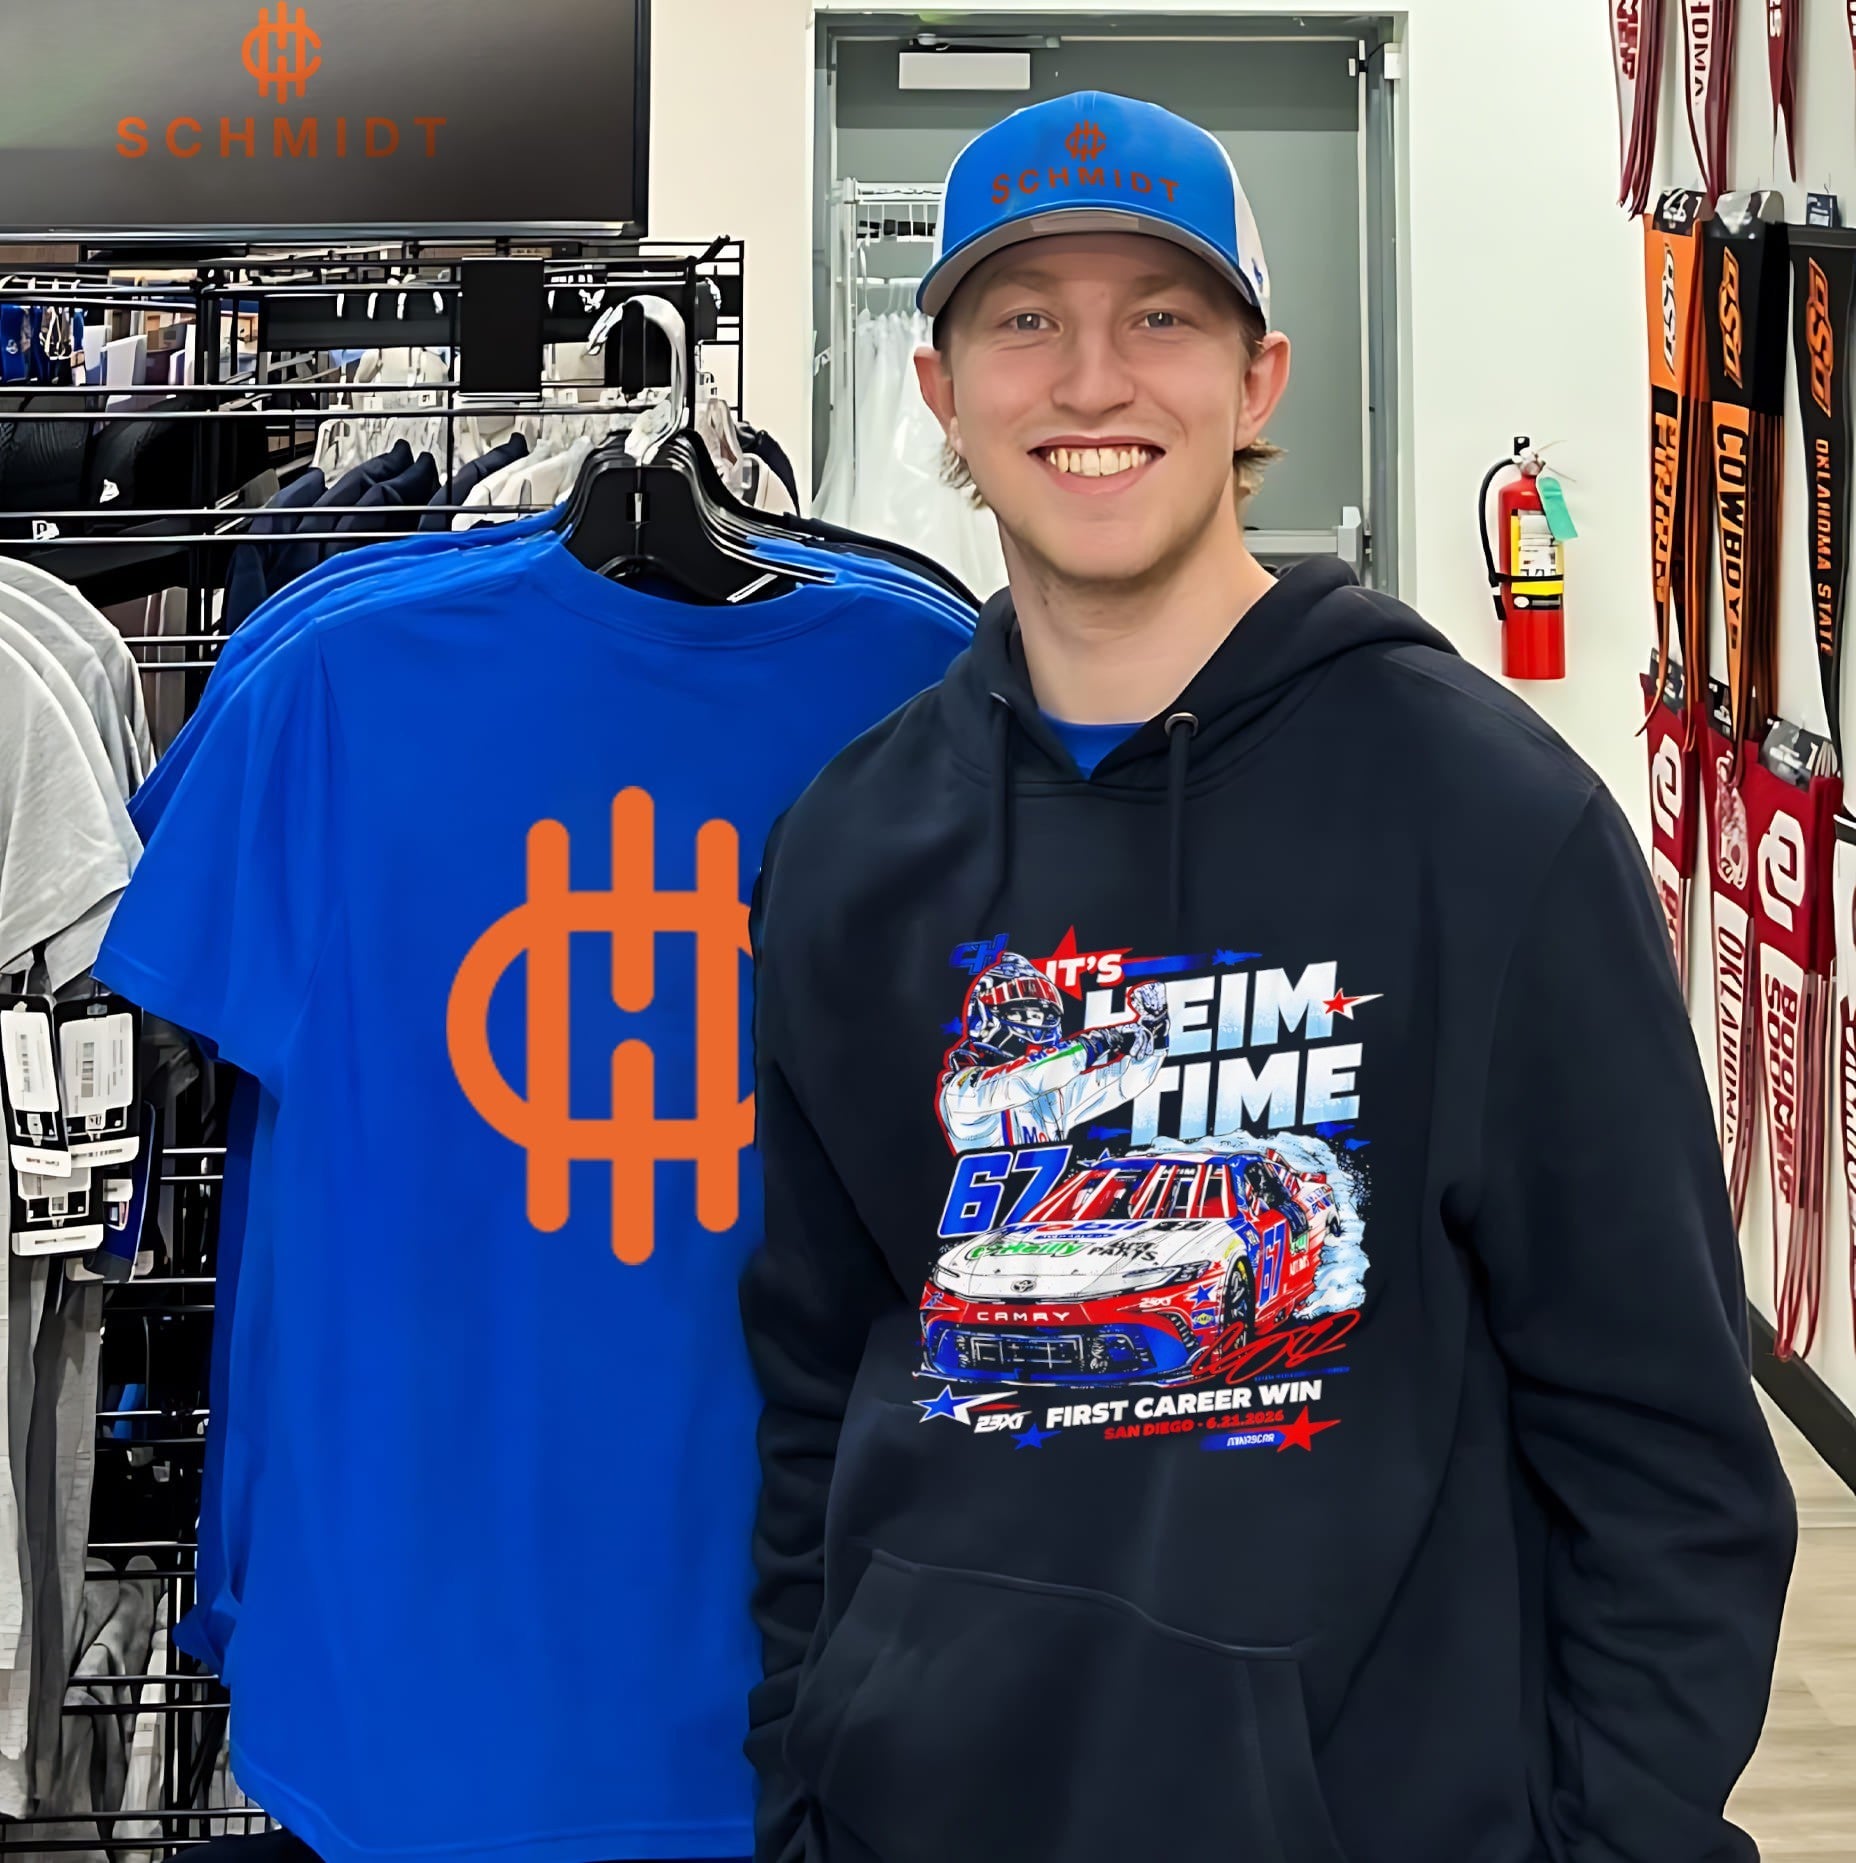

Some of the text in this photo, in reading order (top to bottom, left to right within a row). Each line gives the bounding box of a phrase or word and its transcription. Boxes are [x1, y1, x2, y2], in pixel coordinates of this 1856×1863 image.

[116, 117, 447, 158] SCHMIDT
[992, 167, 1180, 205] SCHMIDT
[1815, 438, 1833, 656] OKLAHOMA STATE
[1046, 953, 1124, 988] IT'S
[1130, 1043, 1363, 1147] TIME
[937, 1145, 1073, 1238] 67
[1258, 1220, 1287, 1308] 67
[977, 1311, 1070, 1321] CAMRY
[1046, 1379, 1323, 1428] FIRST CAREER WIN
[1104, 1409, 1285, 1440] SAN DIEGO 6.21.2026
